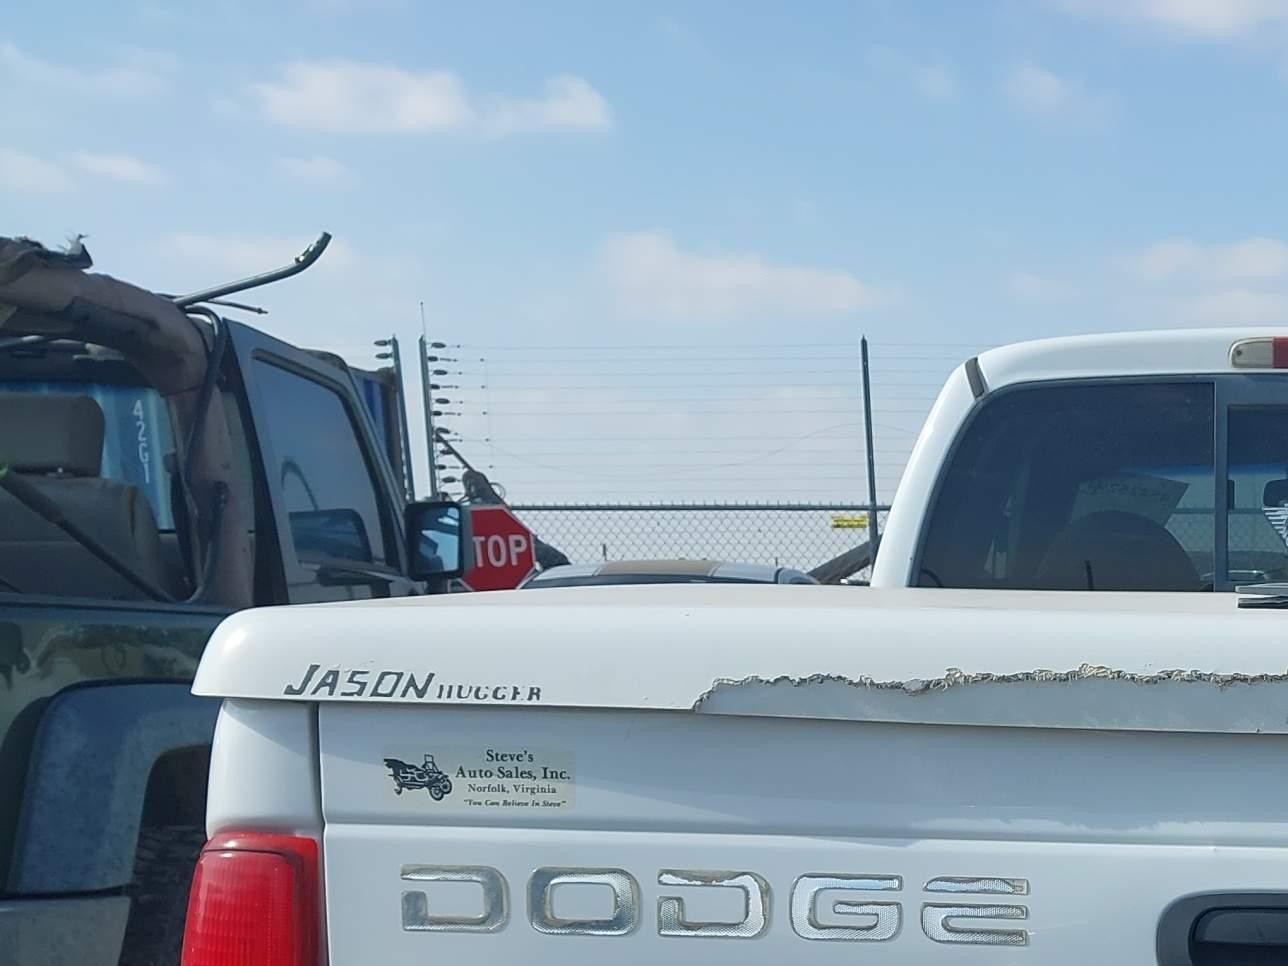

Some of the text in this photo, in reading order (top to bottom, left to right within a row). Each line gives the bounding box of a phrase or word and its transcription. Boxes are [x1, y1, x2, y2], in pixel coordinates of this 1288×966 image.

[472, 534, 528, 568] TOP
[284, 664, 435, 699] JASON
[486, 748, 534, 763] Steve's
[455, 765, 571, 781] Auto Sales, Inc.
[467, 783, 557, 796] Norfolk, Virginia
[400, 865, 1031, 946] DODGE
